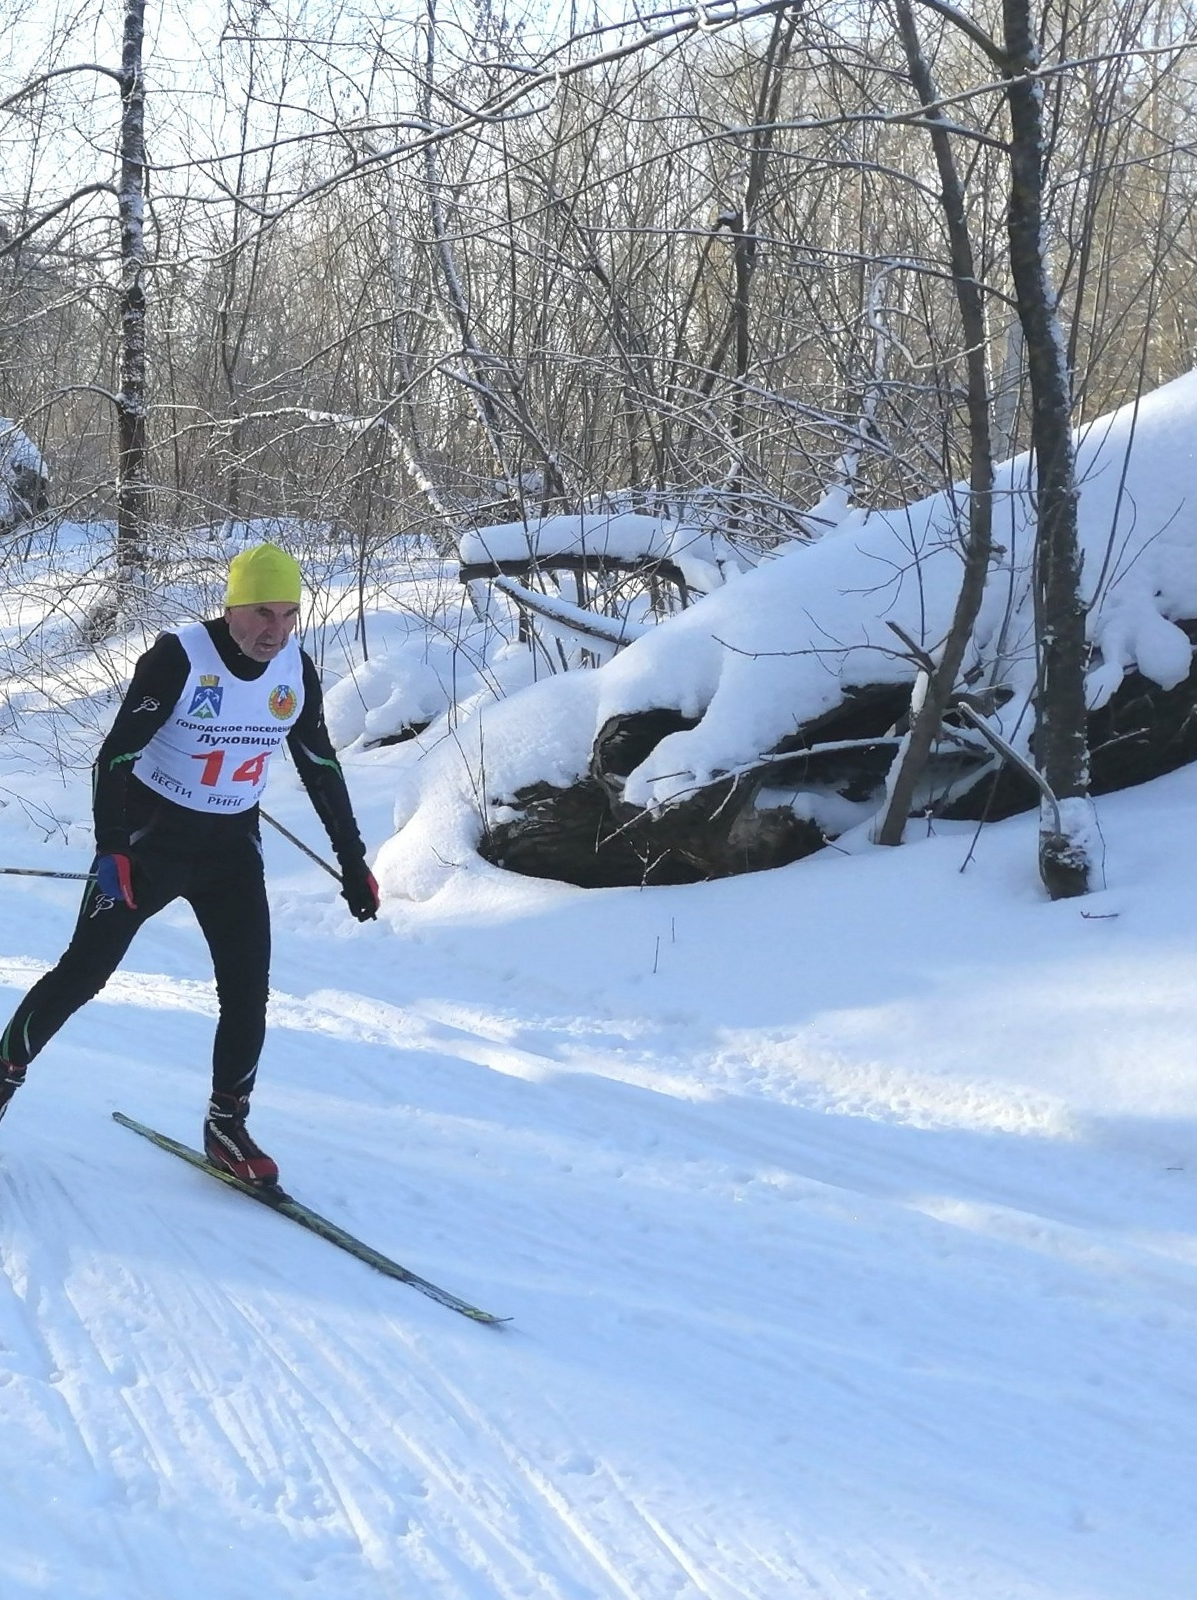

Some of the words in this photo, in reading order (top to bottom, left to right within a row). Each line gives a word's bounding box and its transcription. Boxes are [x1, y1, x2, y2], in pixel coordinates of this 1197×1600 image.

[175, 718, 243, 733] Городское
[196, 733, 282, 747] Луховицы
[190, 749, 273, 788] 14
[150, 770, 193, 799] ВЕСТИ
